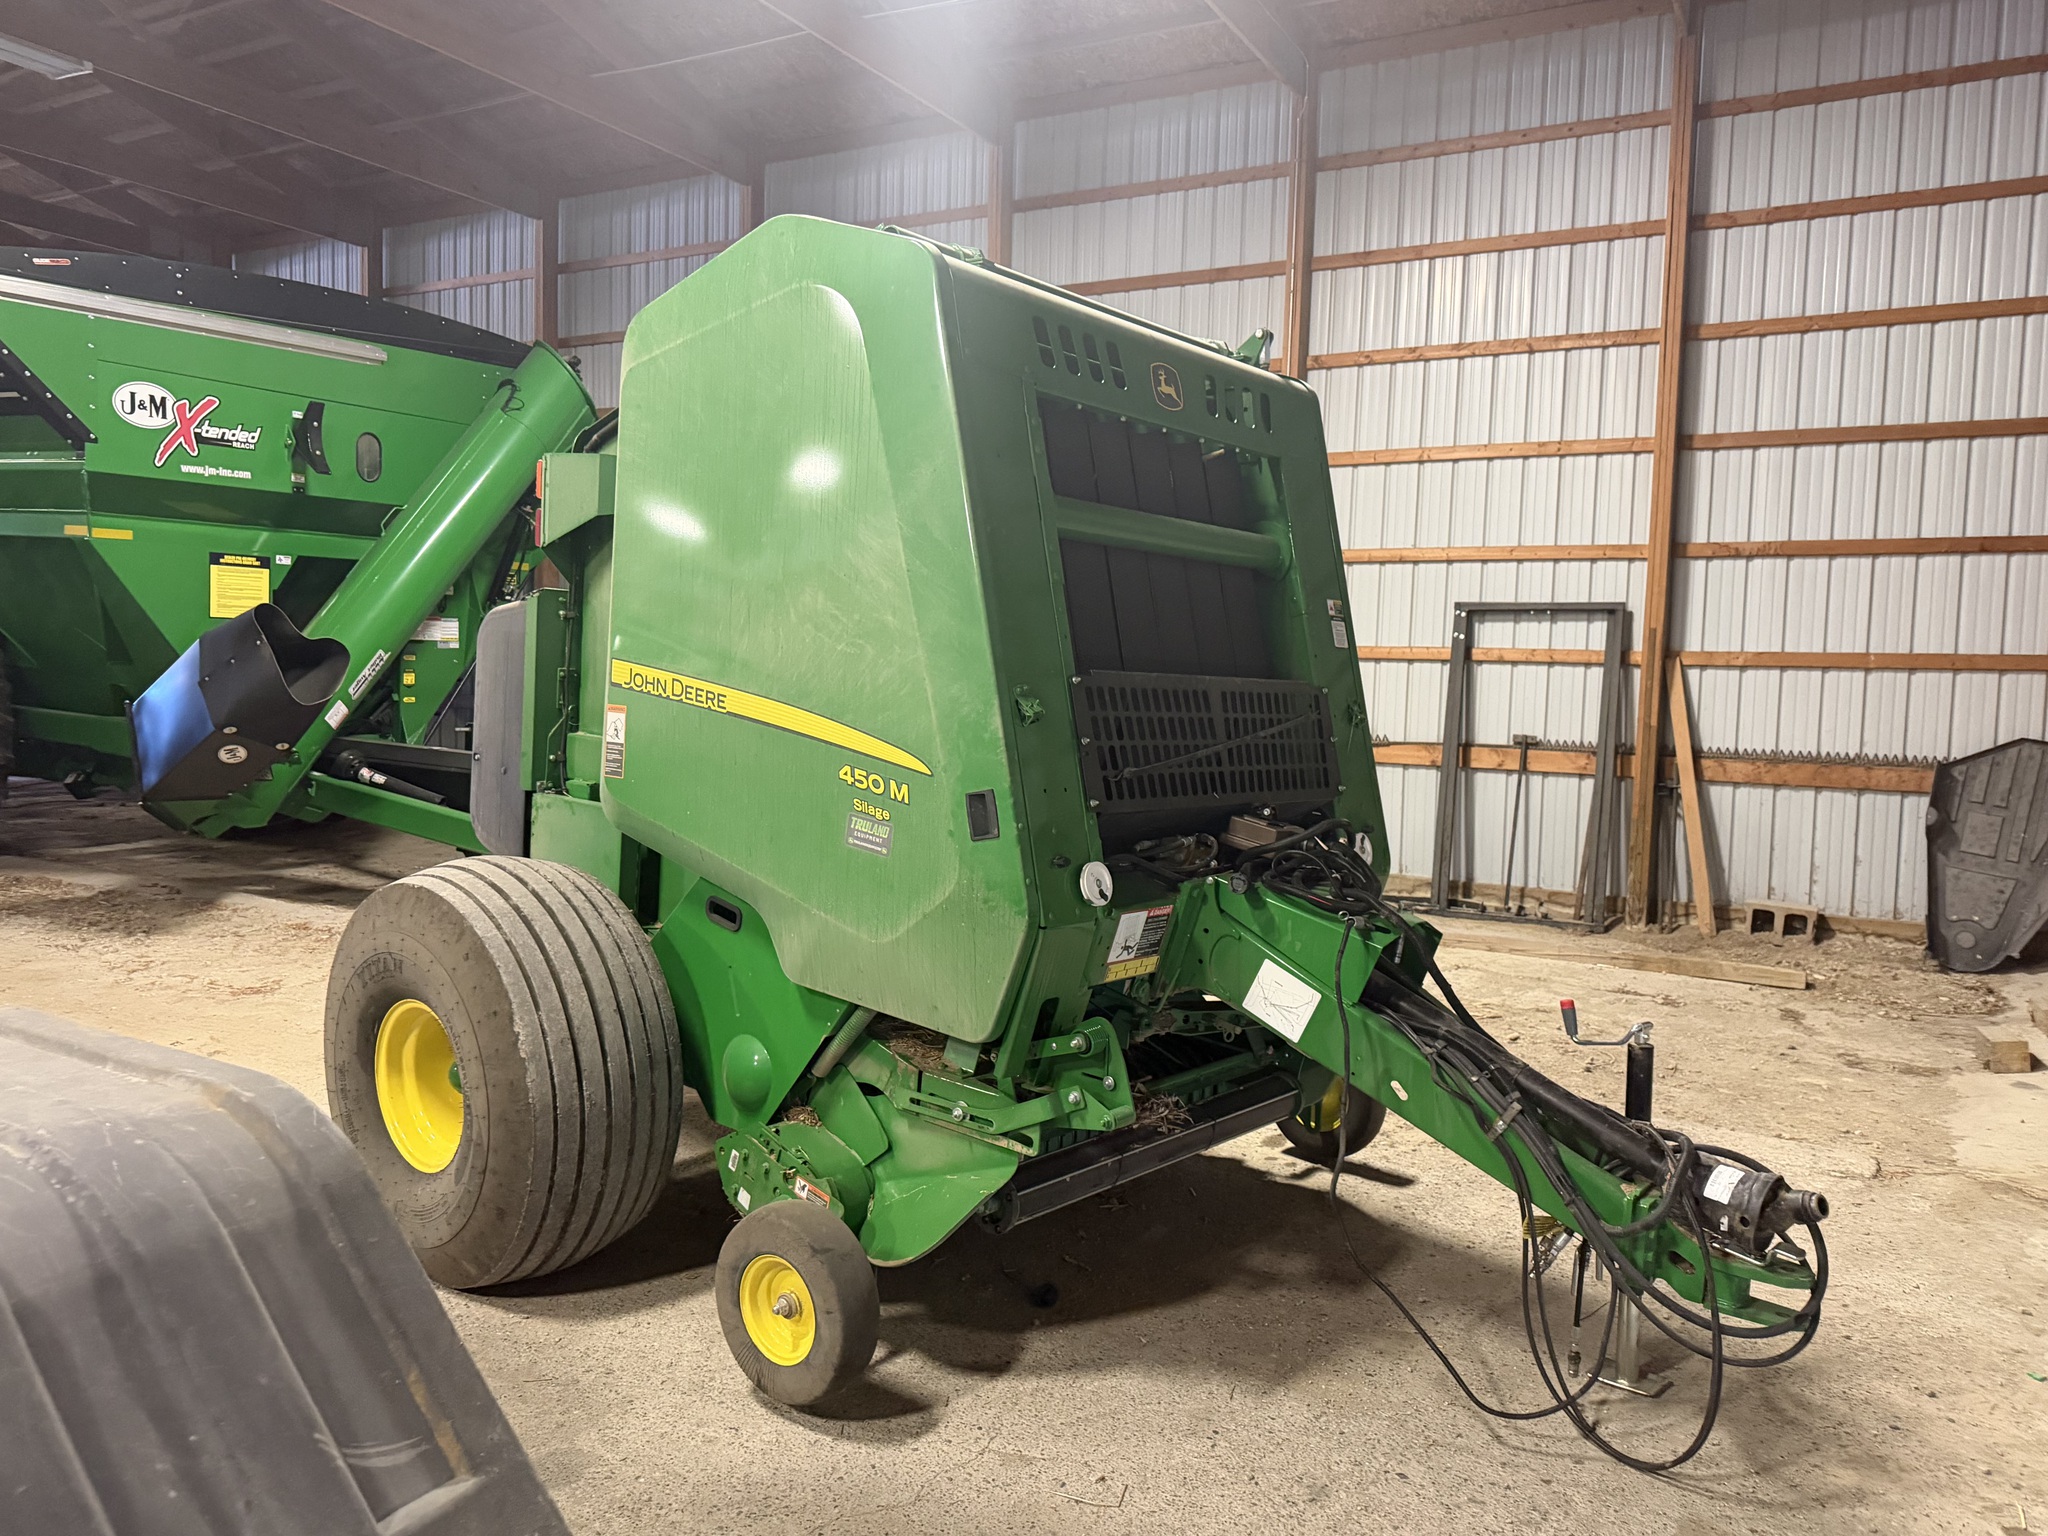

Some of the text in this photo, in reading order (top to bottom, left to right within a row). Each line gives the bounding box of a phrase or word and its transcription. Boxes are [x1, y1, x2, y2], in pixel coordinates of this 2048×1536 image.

[120, 391, 168, 420] J&M
[232, 441, 255, 450] REACH
[180, 465, 252, 479] www.jm-inc.com
[623, 667, 728, 711] JOHN DEERE
[838, 764, 910, 805] 450 M
[852, 797, 891, 821] Silage
[850, 816, 890, 839] TRULAND
